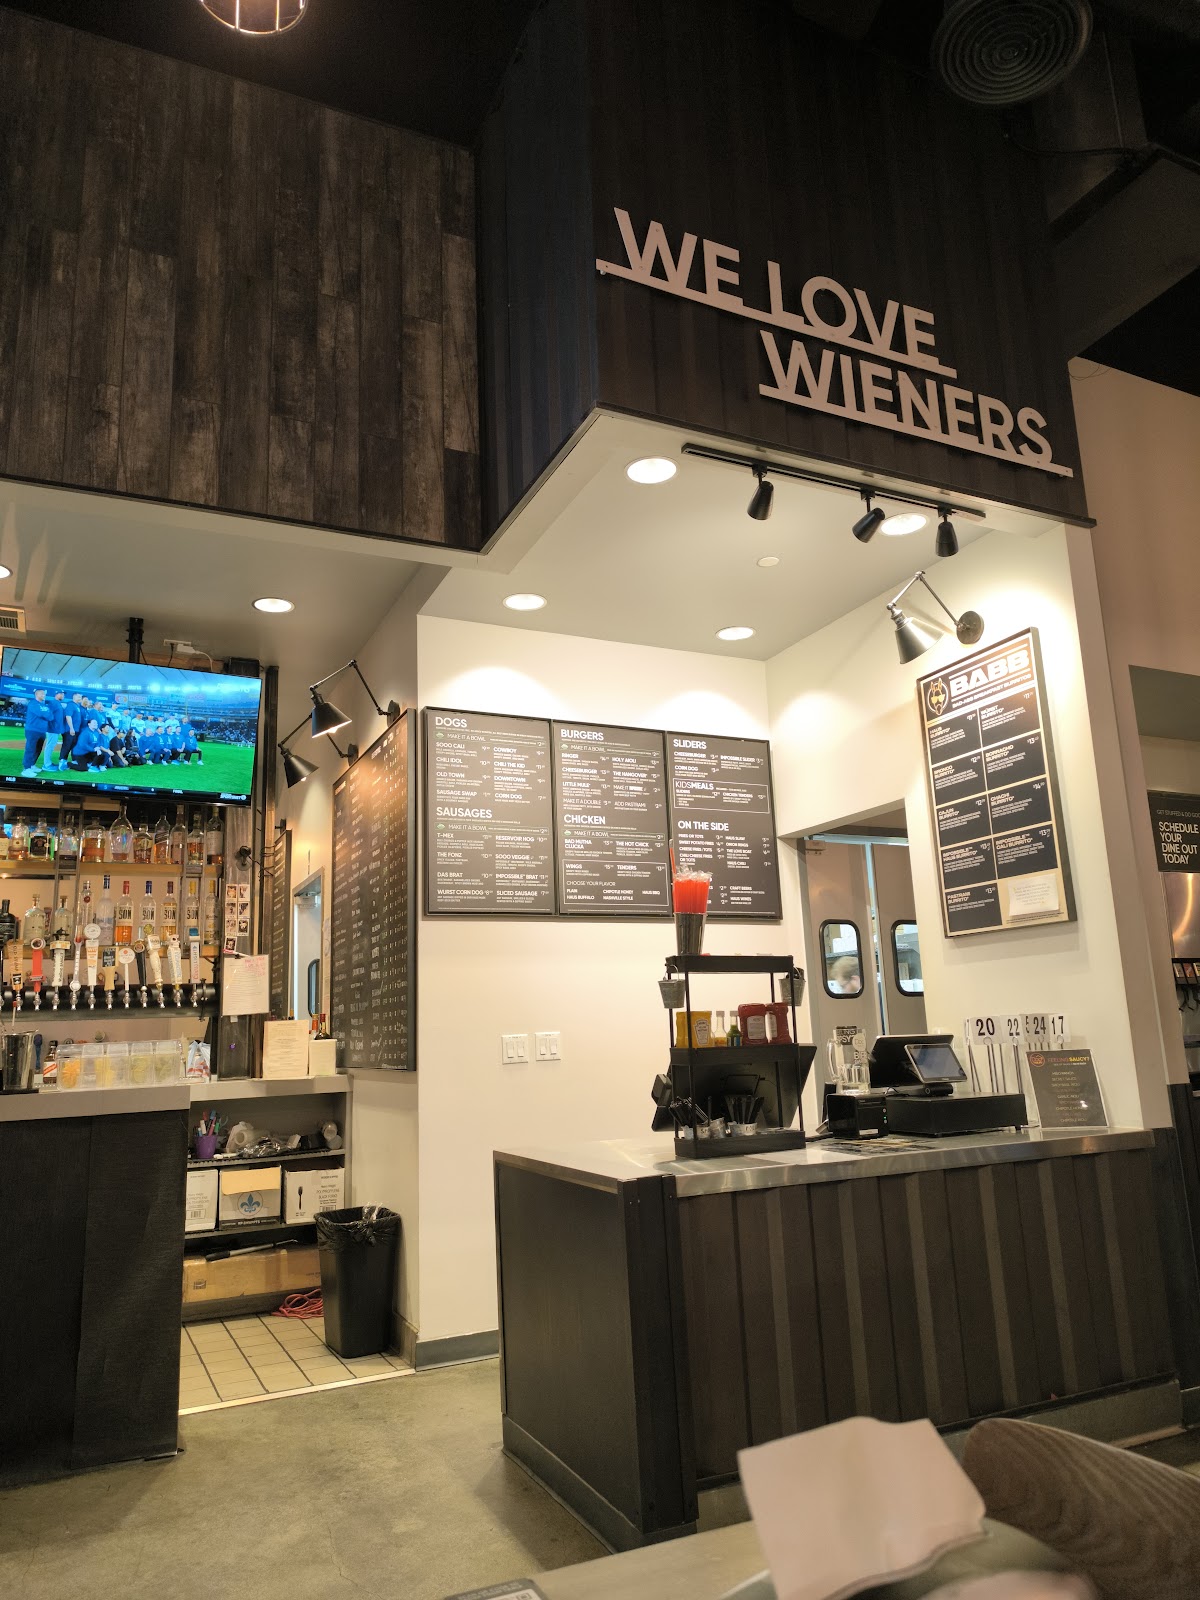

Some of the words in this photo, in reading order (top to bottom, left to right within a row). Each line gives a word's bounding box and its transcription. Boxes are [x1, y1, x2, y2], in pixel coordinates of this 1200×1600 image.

[614, 207, 743, 304] WE
[767, 260, 939, 365] LOVE
[760, 329, 1054, 467] WIENERS
[950, 650, 1029, 697] BABB
[436, 717, 467, 728] DOGS
[561, 729, 604, 740] BURGERS
[673, 739, 707, 749] SLIDERS
[675, 781, 714, 790] KIDSMEALS
[436, 807, 492, 818] SAUSAGES
[564, 814, 606, 824] CHICKEN
[678, 821, 691, 829] ON
[693, 822, 709, 830] THE
[710, 822, 729, 831] SIDE
[1158, 822, 1199, 833] SCHEDULE
[1160, 832, 1182, 843] YOUR
[1162, 843, 1180, 853] DINE
[1181, 845, 1197, 854] OUT
[1163, 853, 1189, 864] TODAY
[976, 1018, 995, 1036] 20
[1008, 1018, 1020, 1036] 22
[1033, 1016, 1046, 1034] 24
[1052, 1016, 1064, 1034] 17
